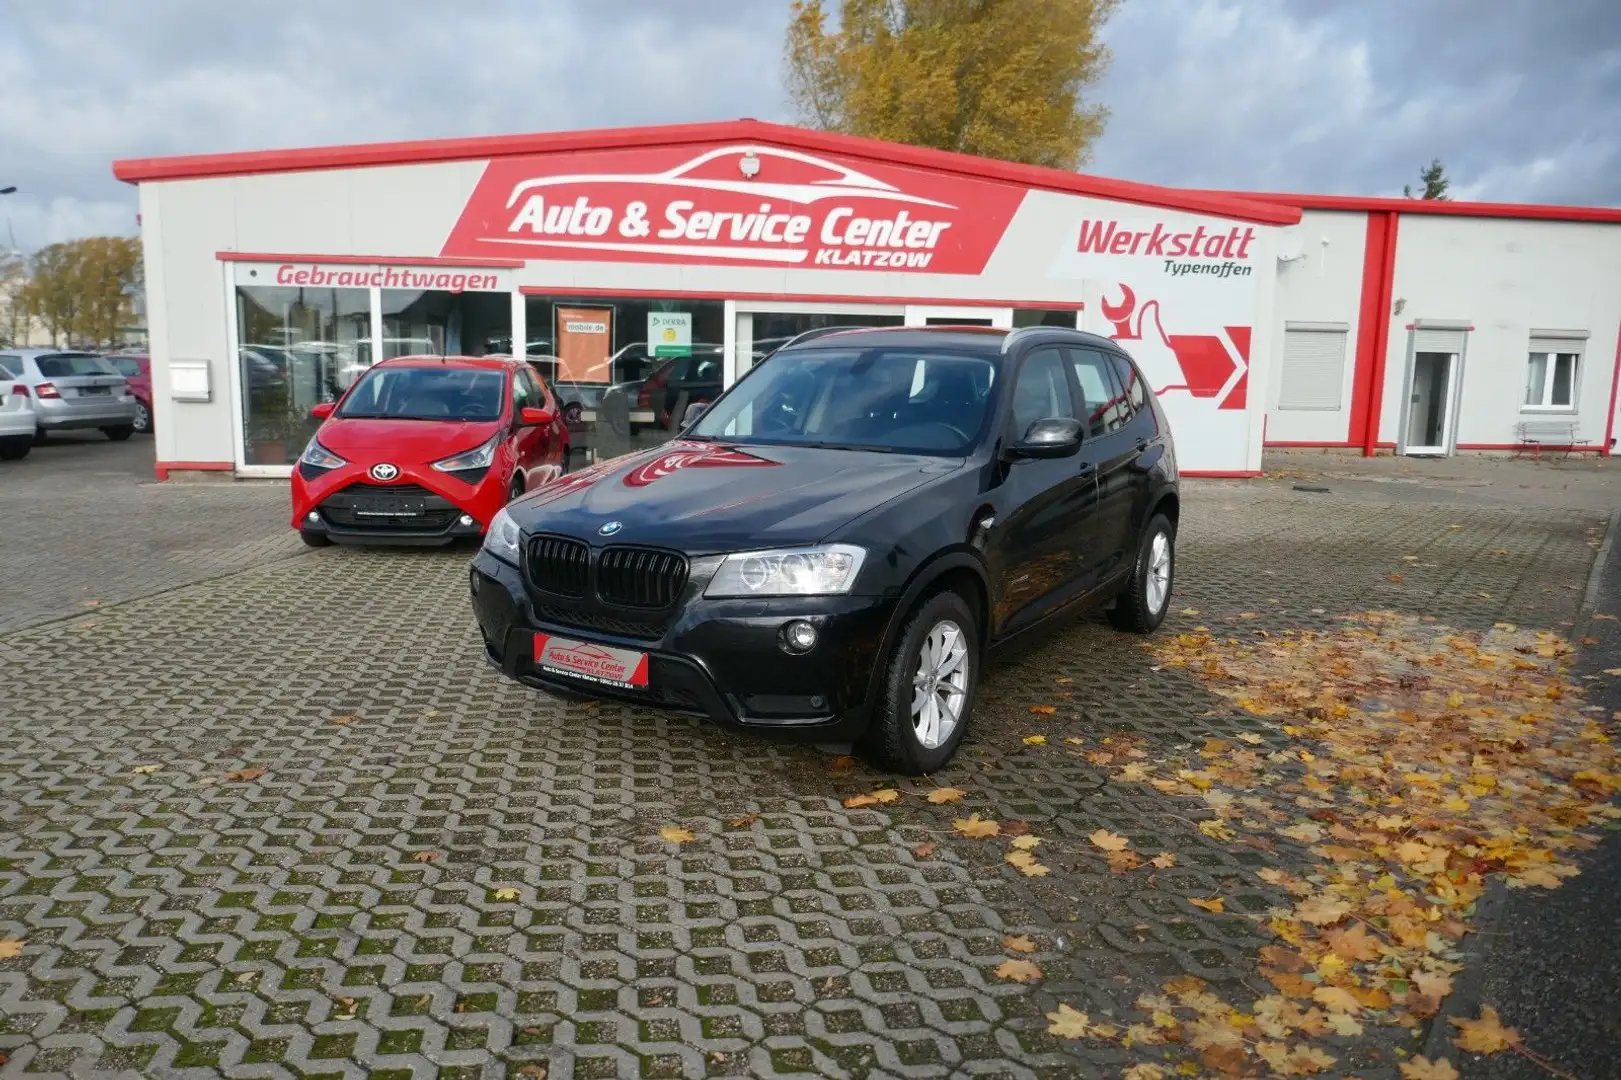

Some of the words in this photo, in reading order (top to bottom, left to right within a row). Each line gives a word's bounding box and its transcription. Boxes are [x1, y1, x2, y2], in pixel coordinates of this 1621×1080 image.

[508, 195, 613, 236] Auto
[618, 201, 651, 237] &
[658, 200, 812, 243] Service
[820, 207, 952, 248] Center
[1077, 220, 1256, 259] Werkstatt
[814, 248, 933, 268] KLATZOW
[276, 264, 498, 294] Gebrauchtwagen
[1164, 260, 1252, 278] Typenoffen
[568, 323, 604, 332] mobile.de
[662, 318, 687, 326] DEKRA
[549, 651, 565, 662] Auto
[572, 655, 600, 667] Service
[601, 661, 626, 673] Center
[586, 667, 623, 679] KLATZOW
